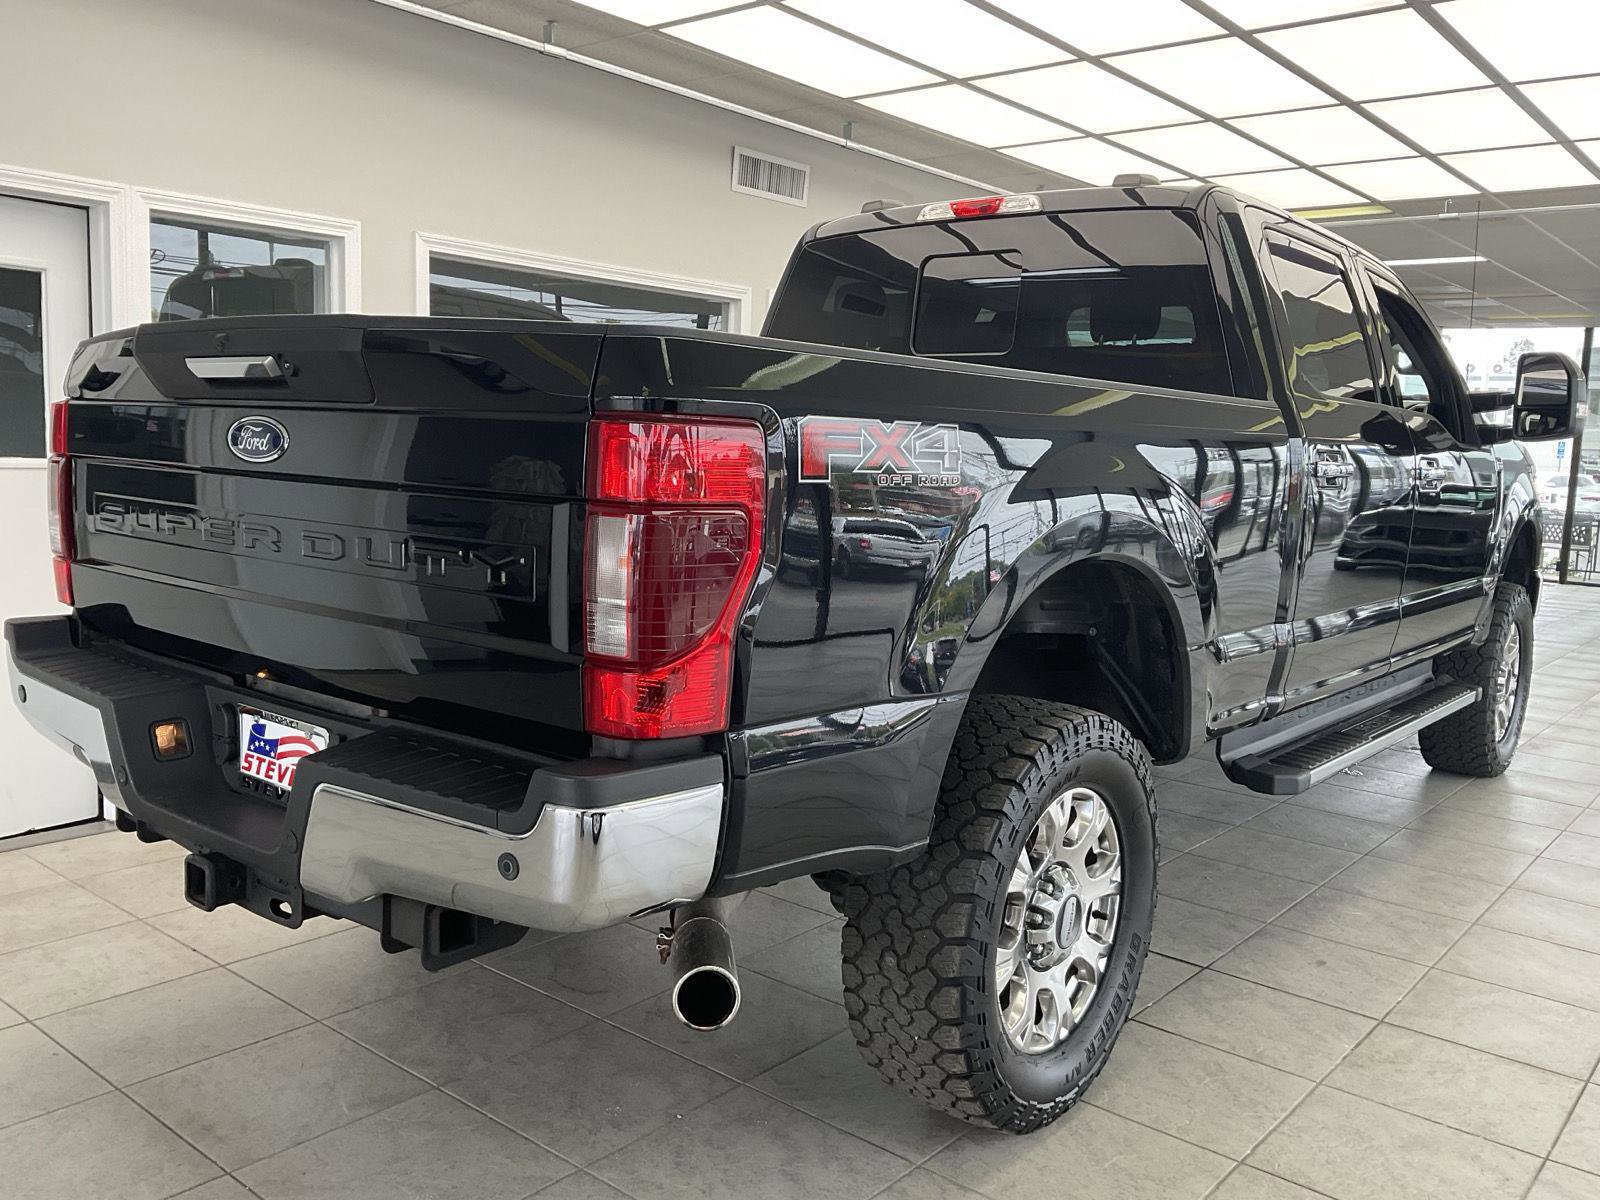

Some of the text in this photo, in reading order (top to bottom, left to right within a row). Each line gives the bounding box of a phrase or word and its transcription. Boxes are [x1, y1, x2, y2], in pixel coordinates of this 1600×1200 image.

[237, 424, 271, 451] Ford
[798, 414, 962, 483] FX4
[877, 474, 961, 487] OFF ROAD
[93, 501, 527, 586] SUPER DUTY
[1084, 931, 1142, 1063] GRABBER
